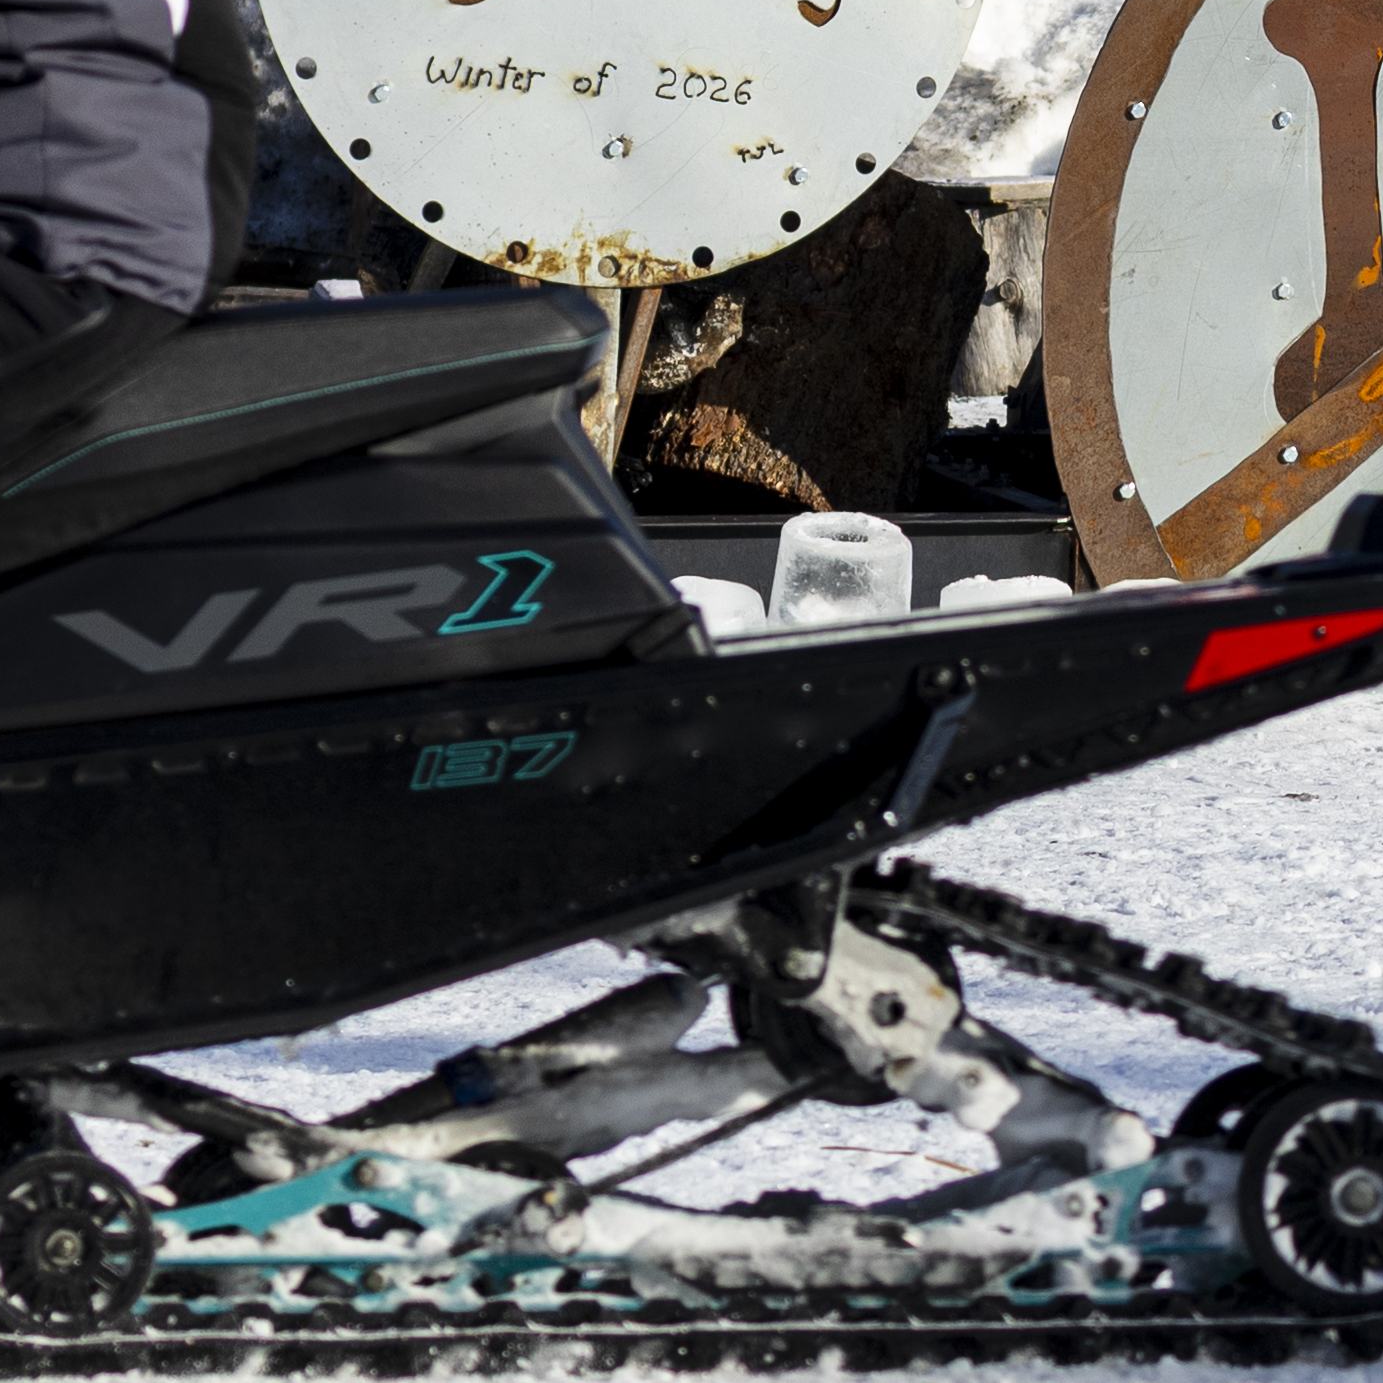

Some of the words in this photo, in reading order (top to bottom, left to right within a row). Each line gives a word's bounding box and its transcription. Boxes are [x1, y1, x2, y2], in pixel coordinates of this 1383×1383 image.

[426, 56, 545, 94] Winter
[573, 62, 617, 97] of
[655, 66, 752, 105] 2026
[53, 549, 556, 675] VR1
[409, 730, 577, 792] 137
